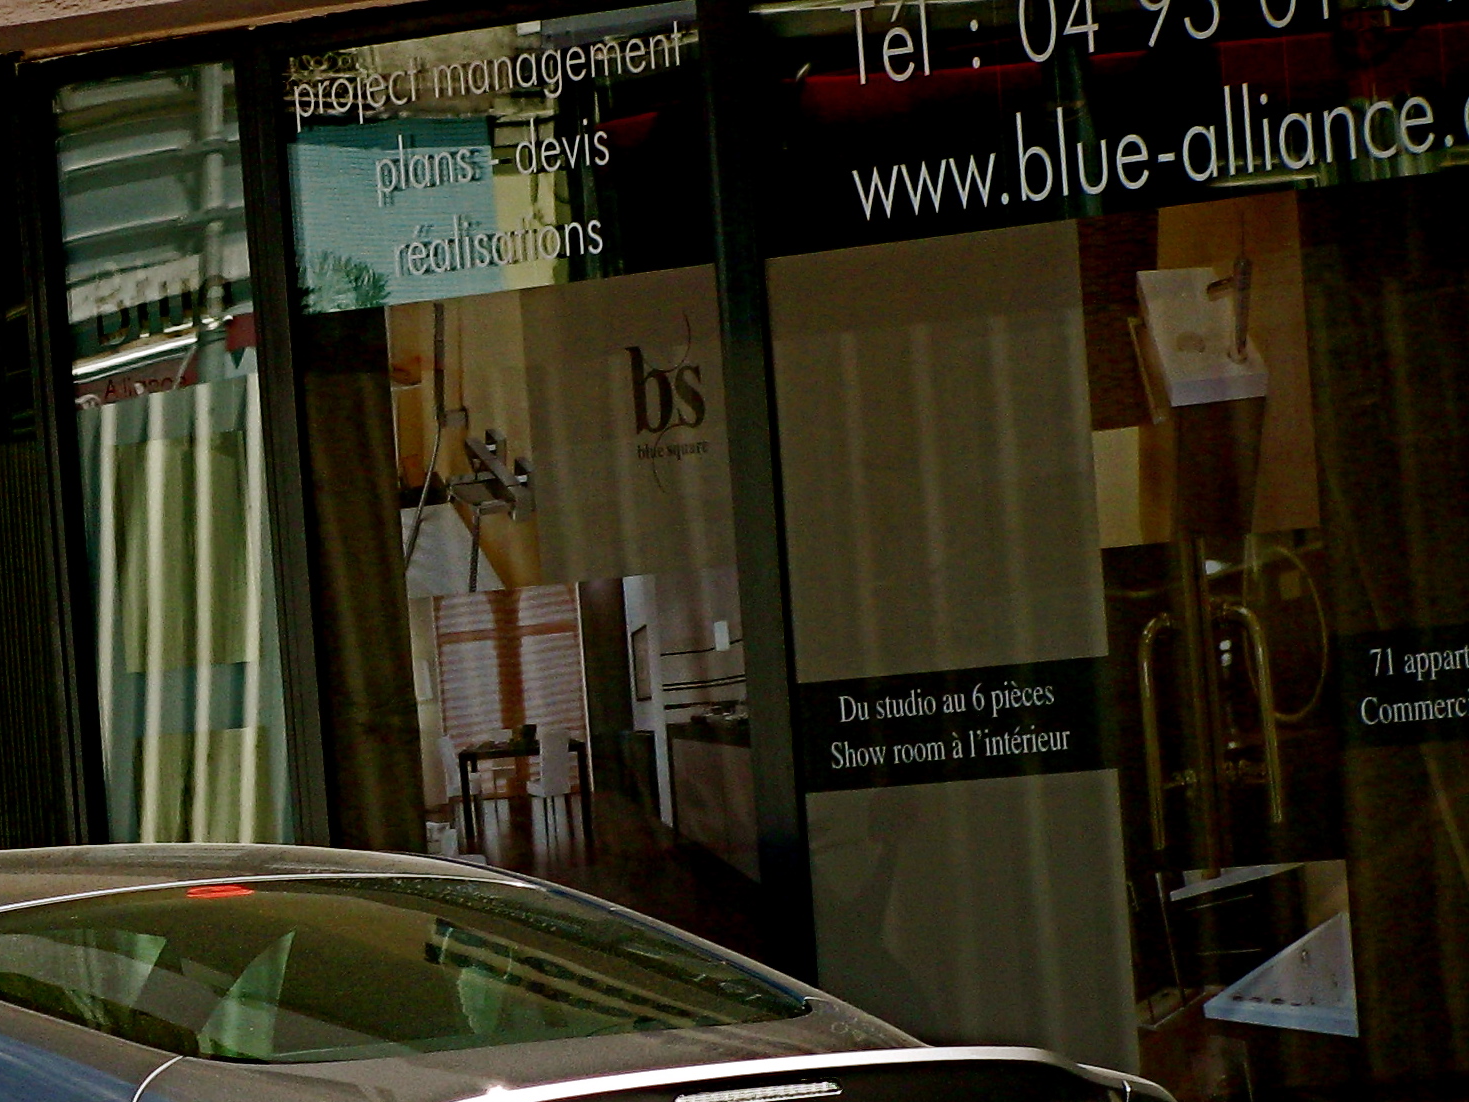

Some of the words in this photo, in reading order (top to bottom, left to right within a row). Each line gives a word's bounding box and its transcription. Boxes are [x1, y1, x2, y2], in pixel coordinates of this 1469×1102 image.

[293, 61, 420, 130] project
[433, 20, 684, 99] management
[841, 2, 932, 85] Tél
[375, 133, 473, 206] plans
[515, 118, 611, 176] devis
[852, 83, 1469, 221] www.blue-alliance.
[394, 212, 604, 278] réalisations
[1369, 646, 1395, 677] 71
[838, 694, 870, 724] Du
[875, 687, 937, 722] studio
[942, 691, 966, 714] au
[971, 689, 986, 711] 6
[990, 681, 1055, 718] pièces
[830, 740, 886, 770] Show
[892, 742, 946, 766] room
[952, 731, 964, 758] à
